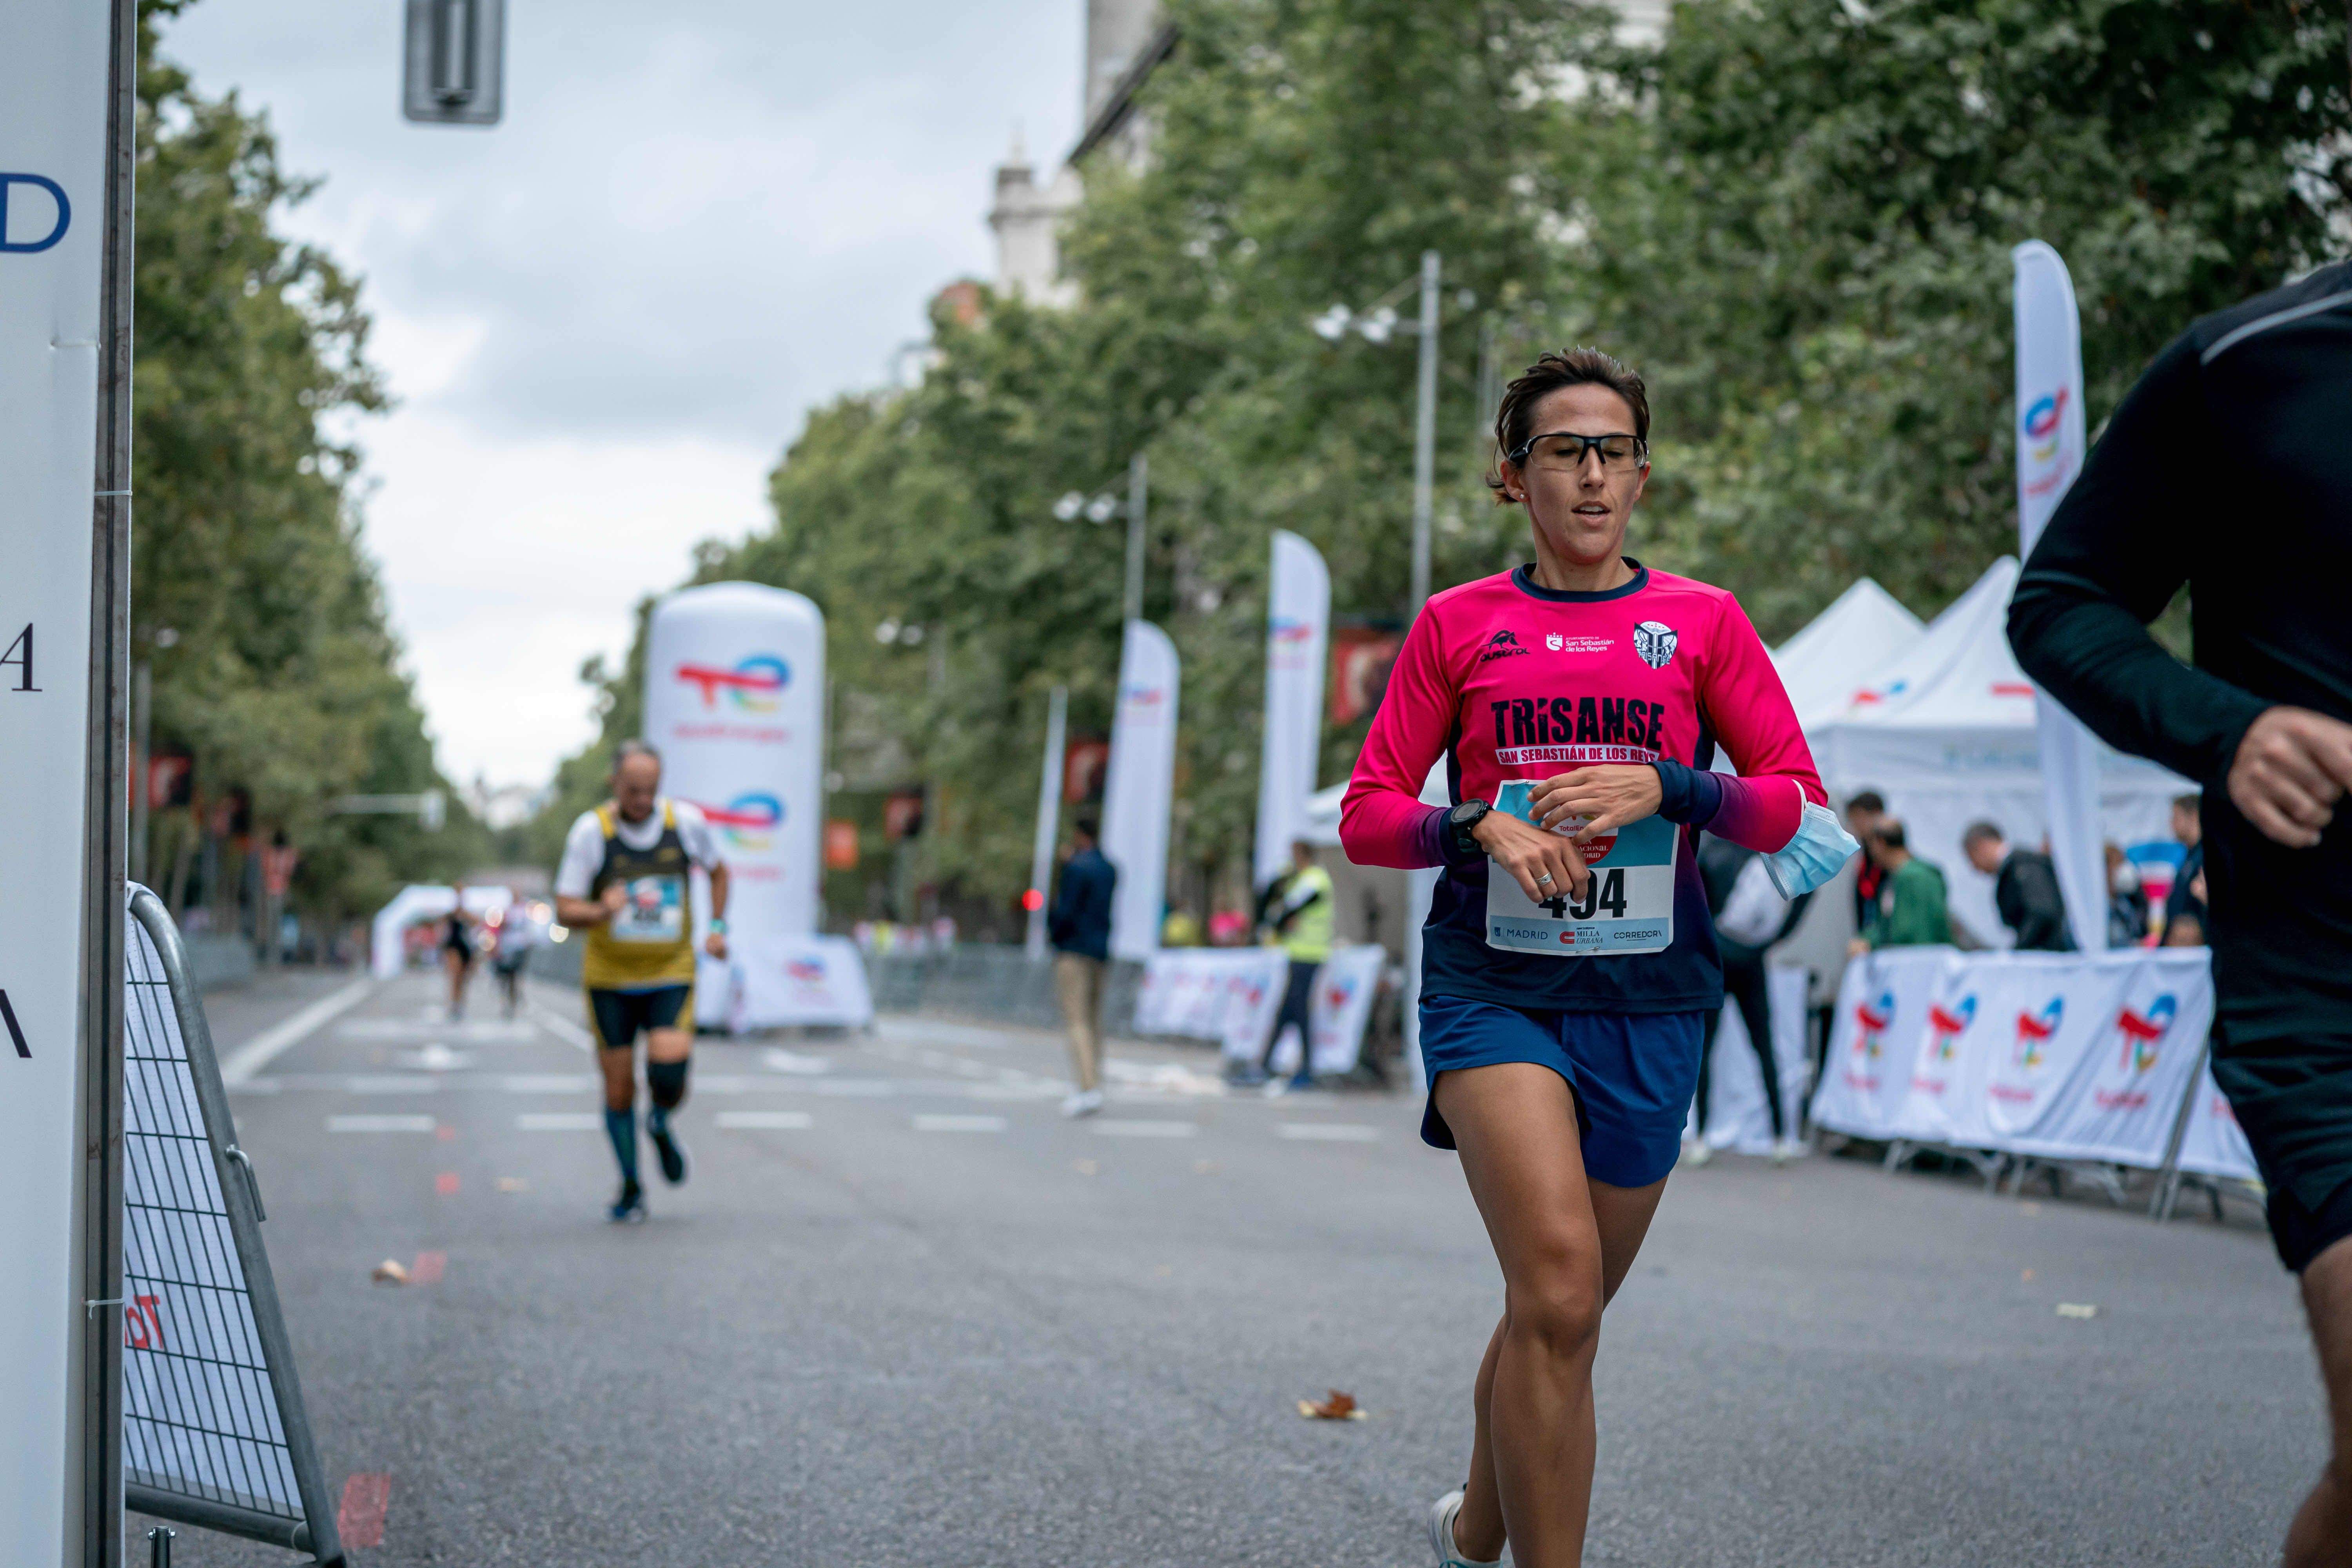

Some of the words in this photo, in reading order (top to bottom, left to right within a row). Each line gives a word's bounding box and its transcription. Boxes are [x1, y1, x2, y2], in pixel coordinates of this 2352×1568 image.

[1499, 750, 1518, 763] SAN
[1521, 746, 1586, 762] SEBASTIÁN
[1588, 747, 1603, 760] DE
[1606, 747, 1627, 760] LOS
[1630, 749, 1655, 762] REYS
[1507, 929, 1548, 940] MADRID
